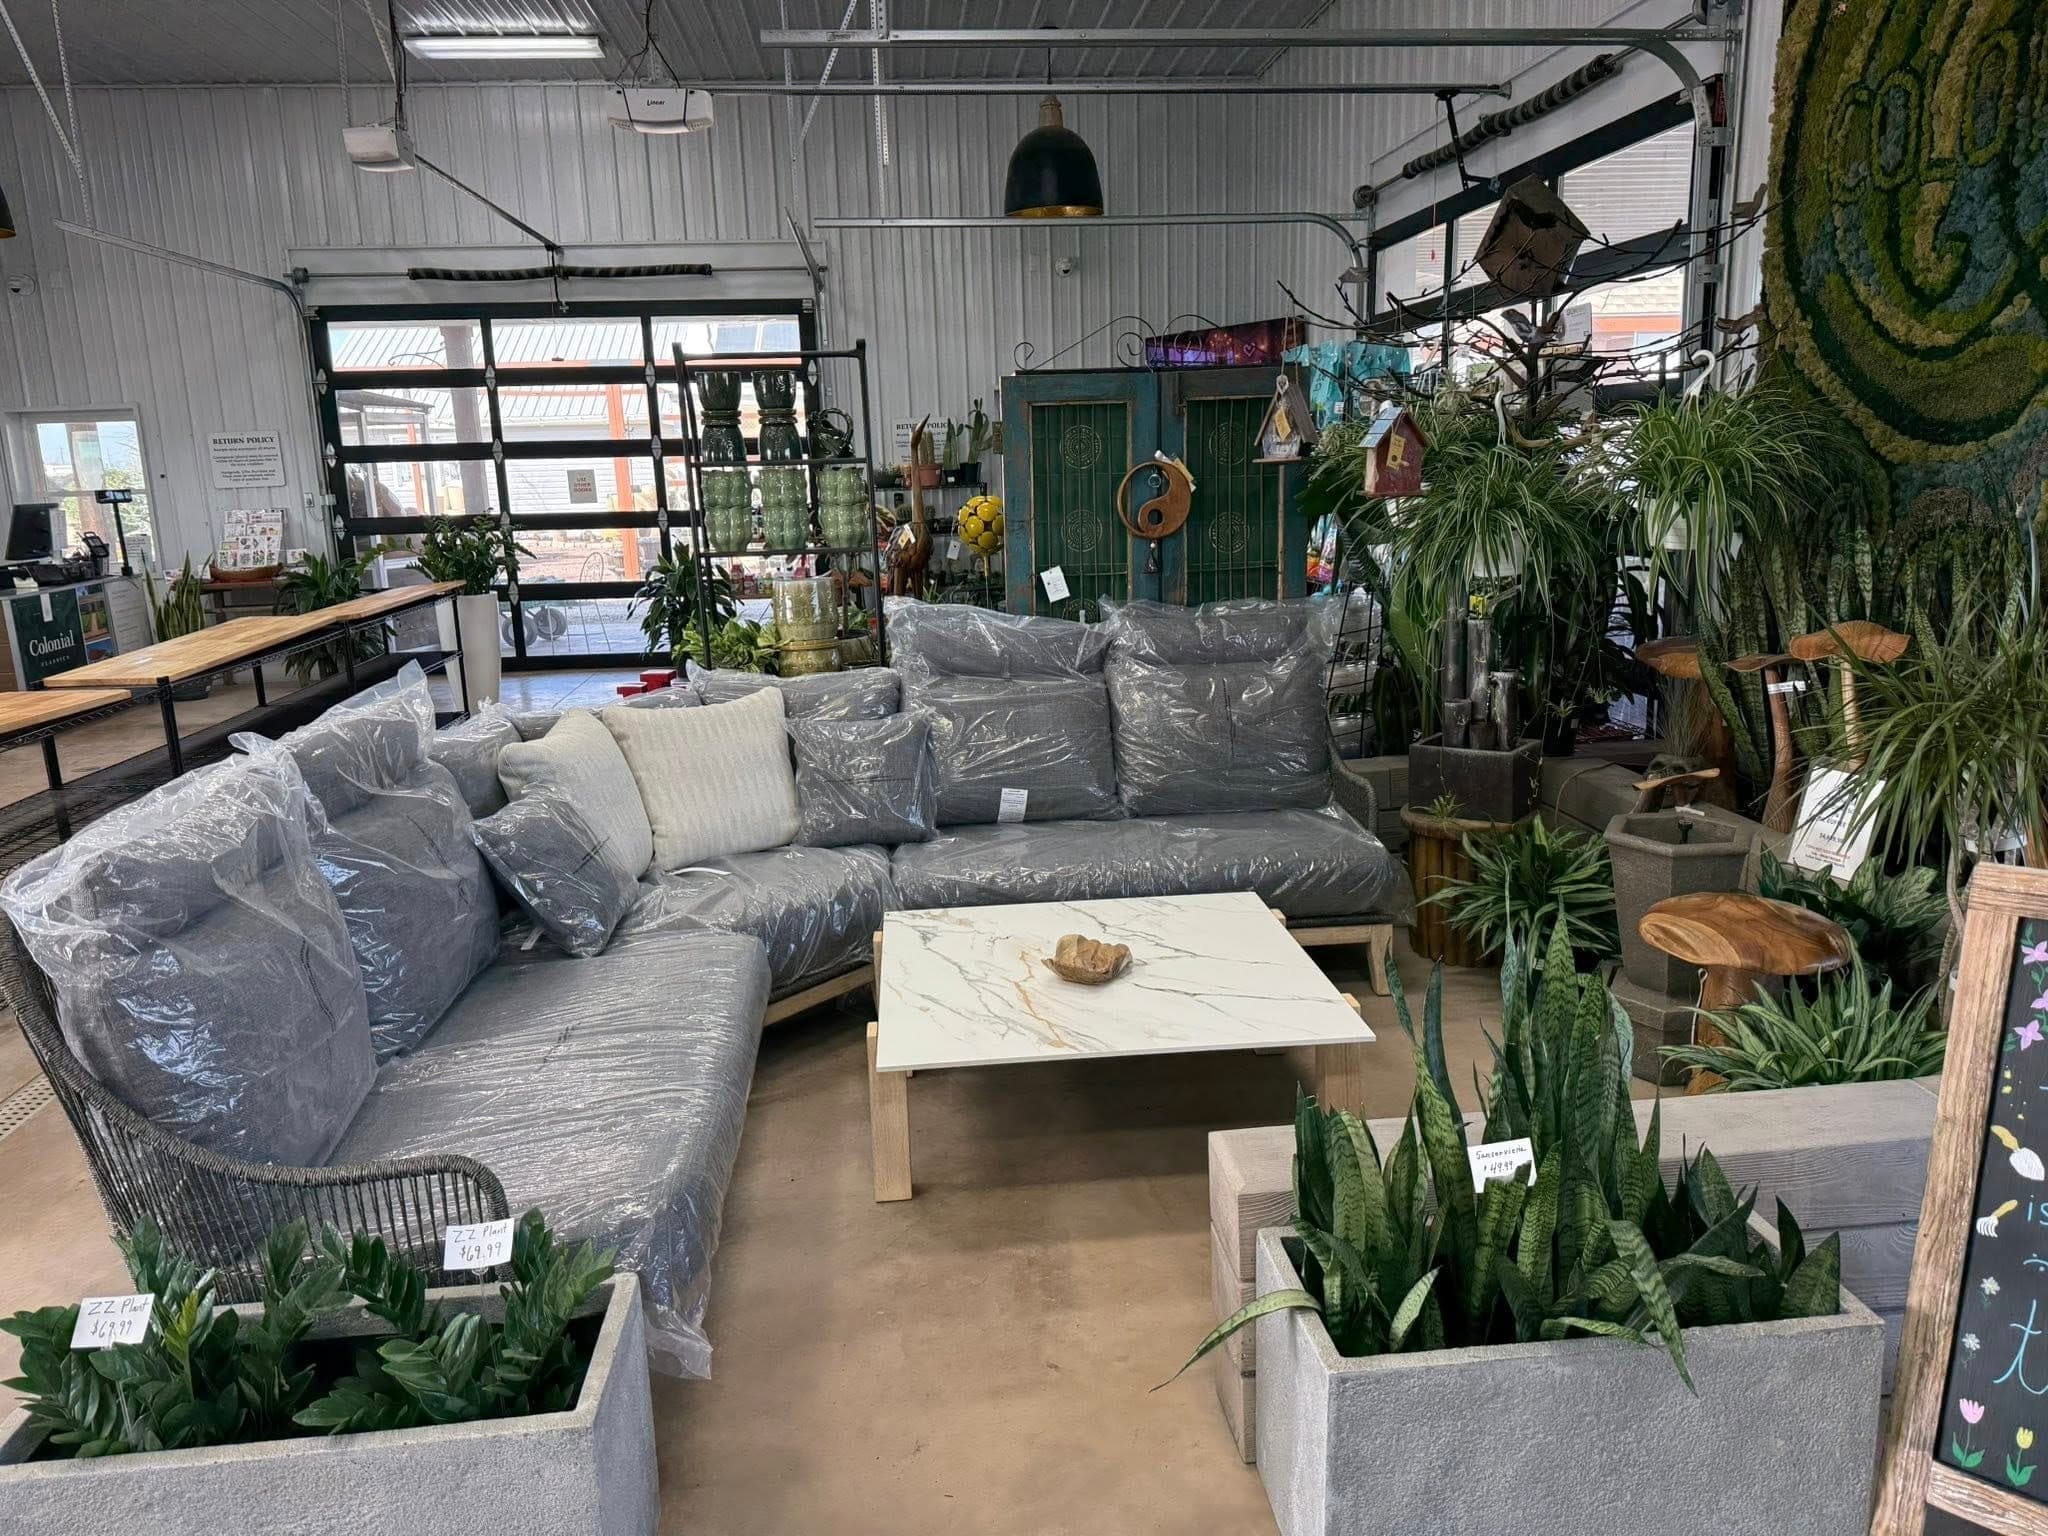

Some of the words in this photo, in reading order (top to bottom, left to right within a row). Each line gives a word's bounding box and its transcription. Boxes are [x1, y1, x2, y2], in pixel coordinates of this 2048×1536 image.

[646, 99, 665, 107] Linear
[212, 437, 245, 445] RETURN
[246, 436, 275, 444] POLICY
[29, 629, 76, 657] Colonial
[452, 1228, 477, 1243] ZZ
[483, 1221, 508, 1237] Plant
[87, 1300, 116, 1316] ZZ
[120, 1296, 150, 1314] Plant
